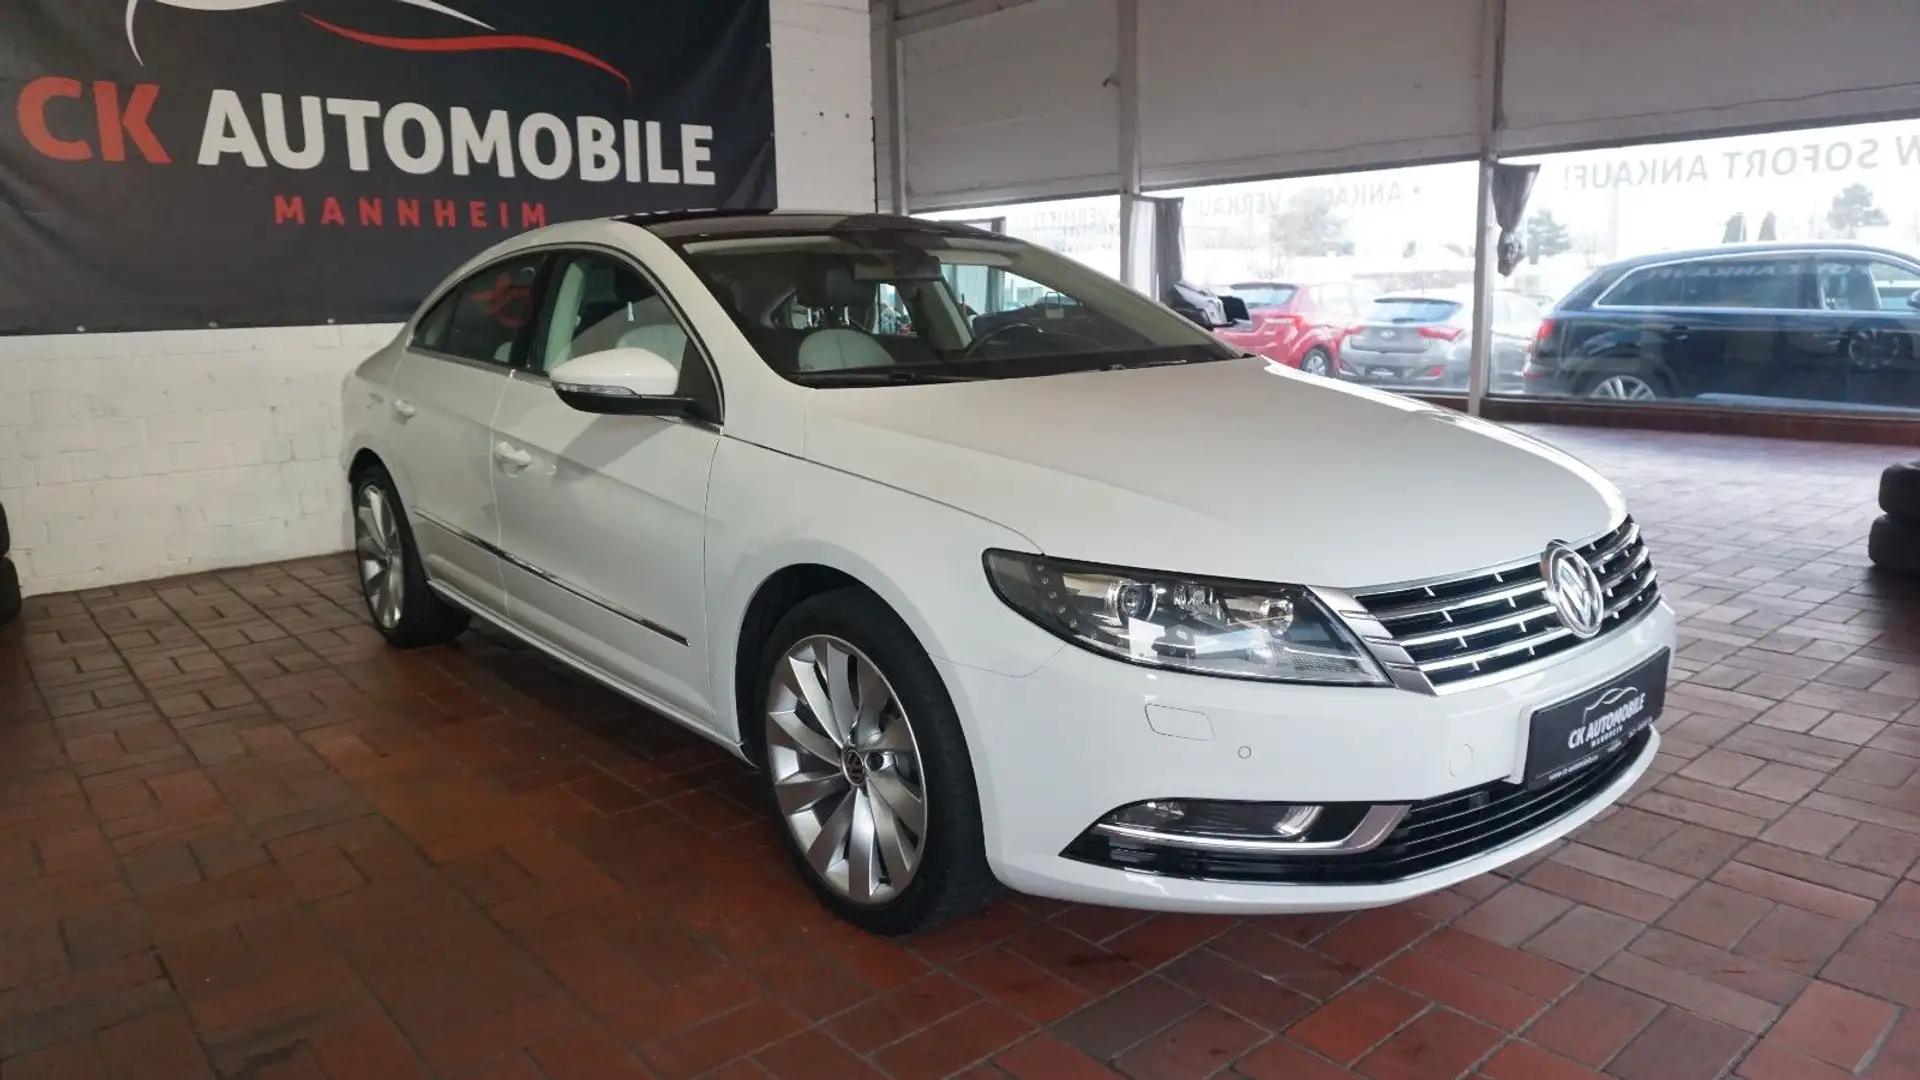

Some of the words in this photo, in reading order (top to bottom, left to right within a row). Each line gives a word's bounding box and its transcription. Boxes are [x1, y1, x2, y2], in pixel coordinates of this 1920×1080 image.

[17, 76, 172, 164] CK
[197, 88, 716, 186] AUTOMOBILE
[275, 195, 547, 228] MANNHEIM
[1568, 726, 1586, 748] CK
[1586, 693, 1646, 742] AUTOMOBILE
